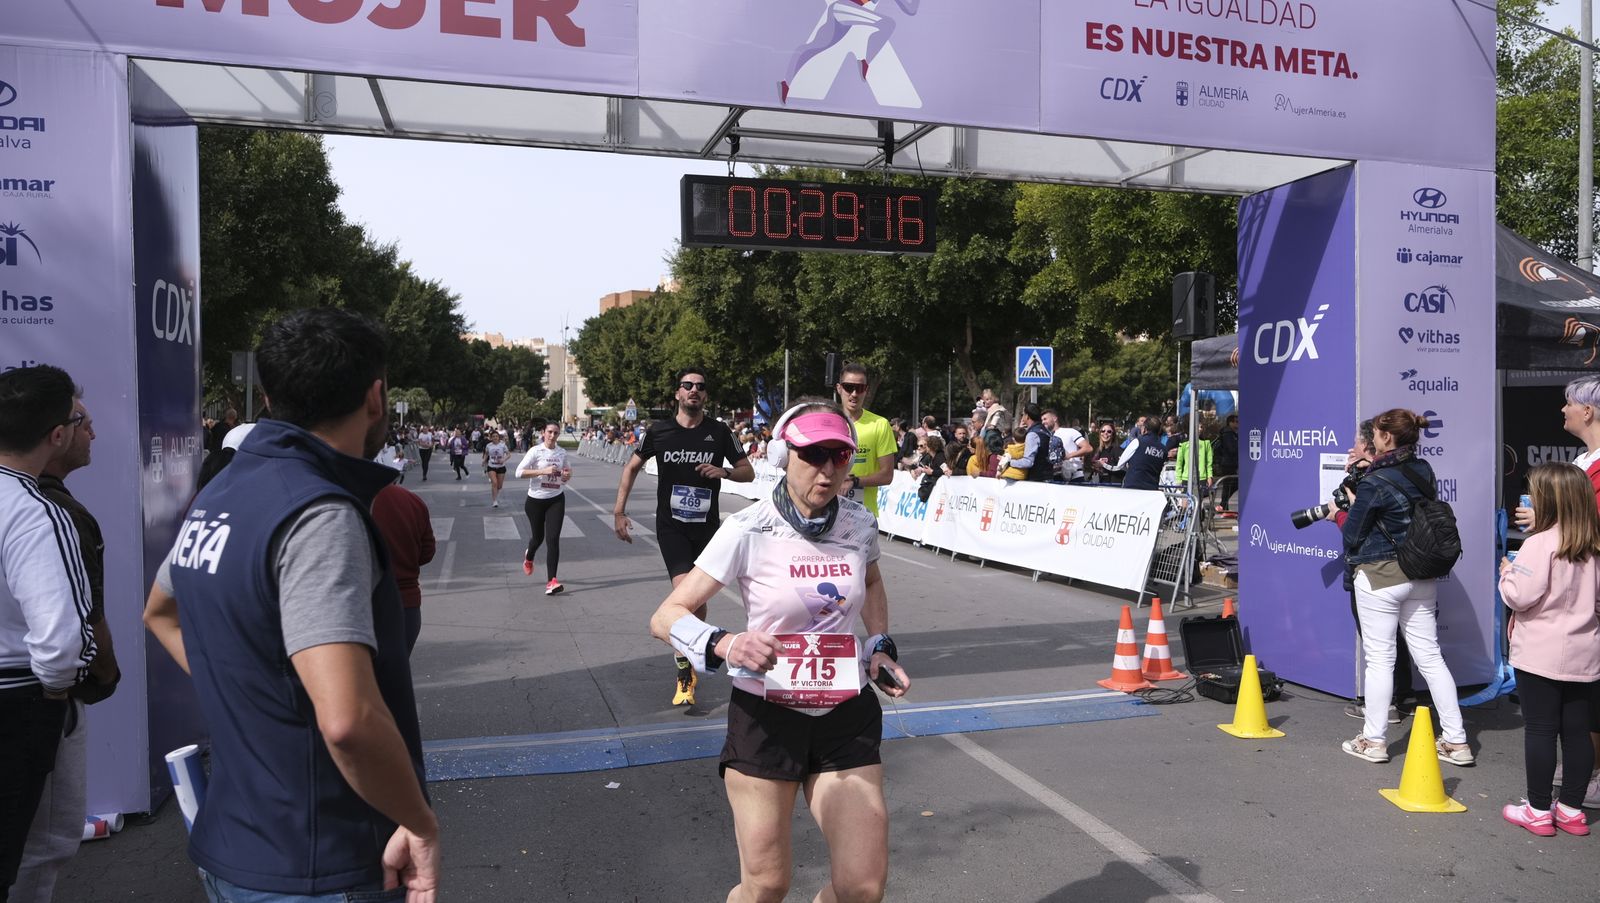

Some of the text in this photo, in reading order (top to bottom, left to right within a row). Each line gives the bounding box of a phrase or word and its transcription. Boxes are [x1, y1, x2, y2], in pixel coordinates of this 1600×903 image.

[1086, 21, 1358, 79] ES NUESTRA META.
[1100, 76, 1148, 103] CDX
[1199, 85, 1249, 101] ALMERÍA
[1198, 99, 1225, 109] CIUDAD
[0, 178, 56, 192] mar
[728, 185, 924, 245] 00:29:16
[1400, 210, 1460, 225] HYUNDAI
[1408, 224, 1453, 236] Almerialva
[1415, 250, 1464, 266] cajamar
[1404, 290, 1446, 314] CASI
[10, 315, 54, 325] cuidarte
[152, 279, 193, 345] CDX
[1254, 304, 1329, 365] CDX
[1417, 329, 1460, 344] vithas
[1408, 376, 1459, 395] aqualia
[1272, 426, 1338, 447] ALMERÍA
[1271, 448, 1304, 459] CIUDAD
[680, 496, 701, 507] 469
[1003, 501, 1056, 525] ALMERÍA
[1000, 521, 1027, 535] CIUDAD
[1084, 512, 1150, 536] ALMERÍA
[1082, 533, 1115, 549] CIUDAD
[789, 563, 853, 578] MUJER
[787, 658, 836, 681] 715
